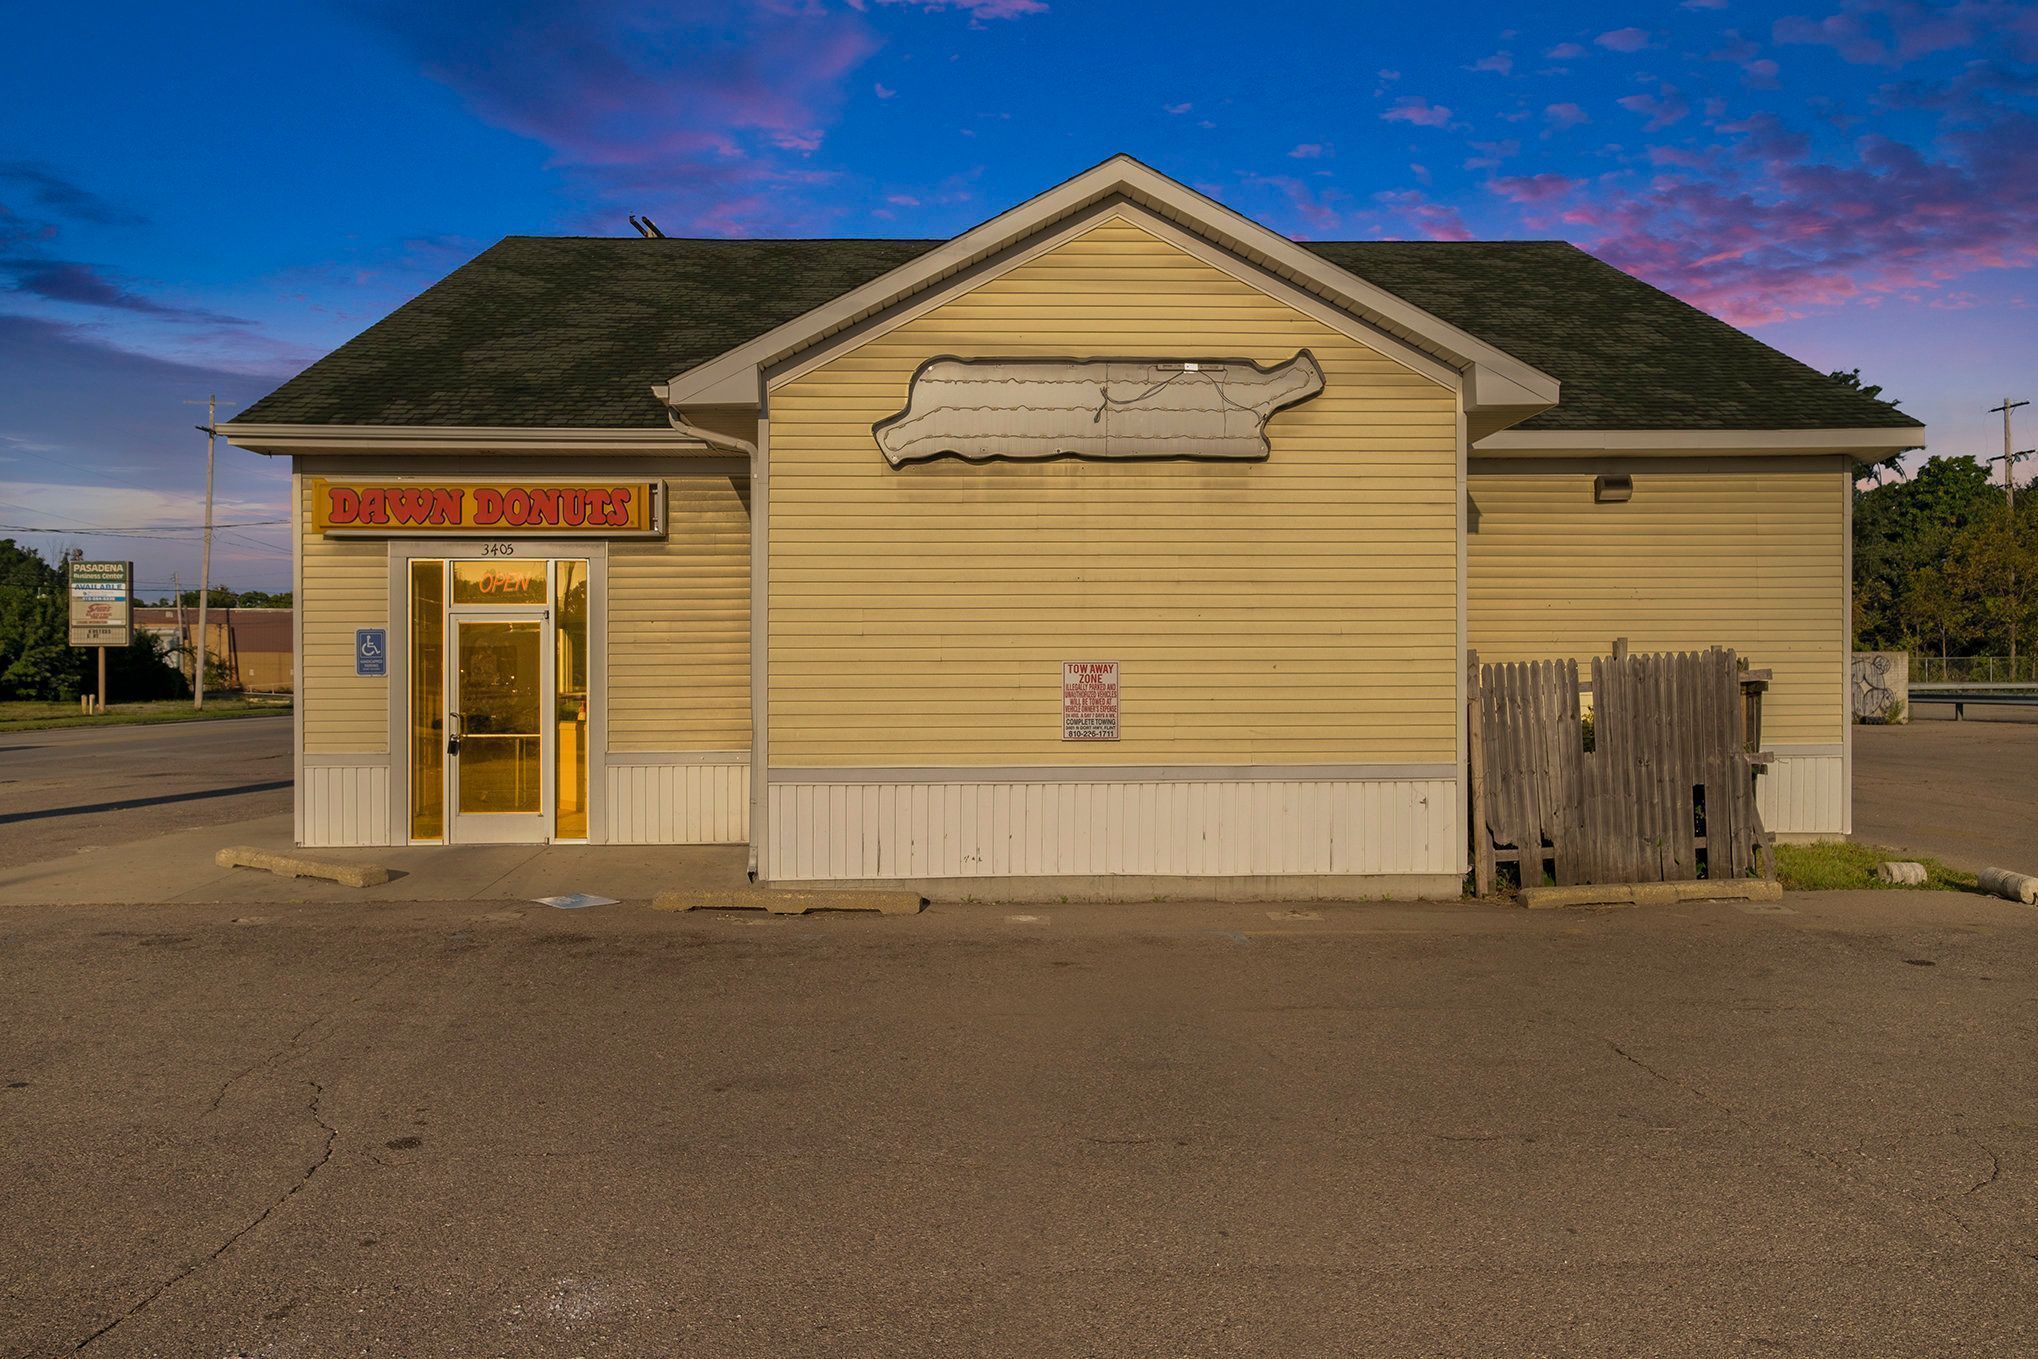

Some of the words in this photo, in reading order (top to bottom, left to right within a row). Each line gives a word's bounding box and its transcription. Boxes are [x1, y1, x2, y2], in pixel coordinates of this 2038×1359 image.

[328, 487, 465, 526] DAWN
[474, 487, 632, 527] DONUTS
[481, 543, 515, 557] 3405
[73, 564, 124, 572] PASADENA
[479, 570, 531, 594] OPEN
[1068, 664, 1088, 673] TOW
[1090, 664, 1114, 673] AWAY
[1079, 674, 1103, 683] ZONE
